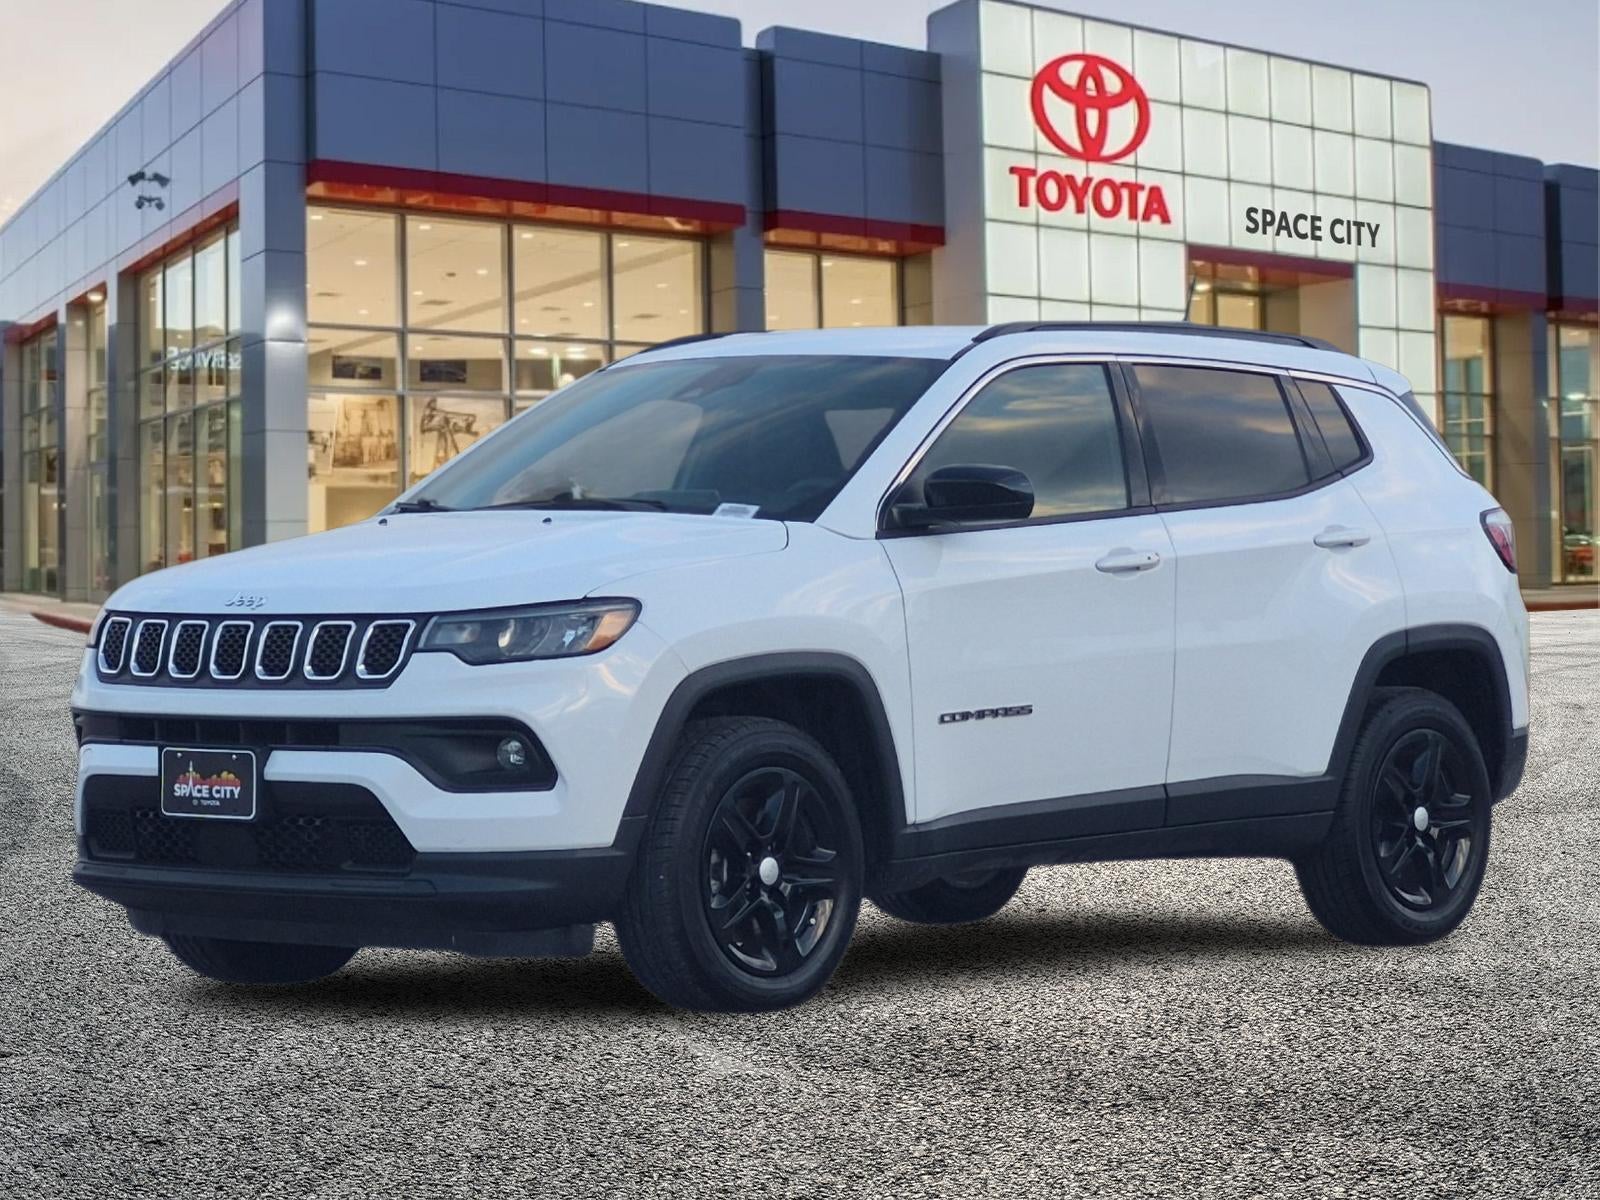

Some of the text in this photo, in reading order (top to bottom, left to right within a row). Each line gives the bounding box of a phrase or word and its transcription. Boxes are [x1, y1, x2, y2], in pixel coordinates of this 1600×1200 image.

[1009, 166, 1171, 224] TOYOTA
[1245, 206, 1381, 248] SPACE CITY
[224, 592, 266, 611] Jeep
[938, 704, 1033, 725] COMPASS
[173, 783, 241, 799] SPACE CITY
